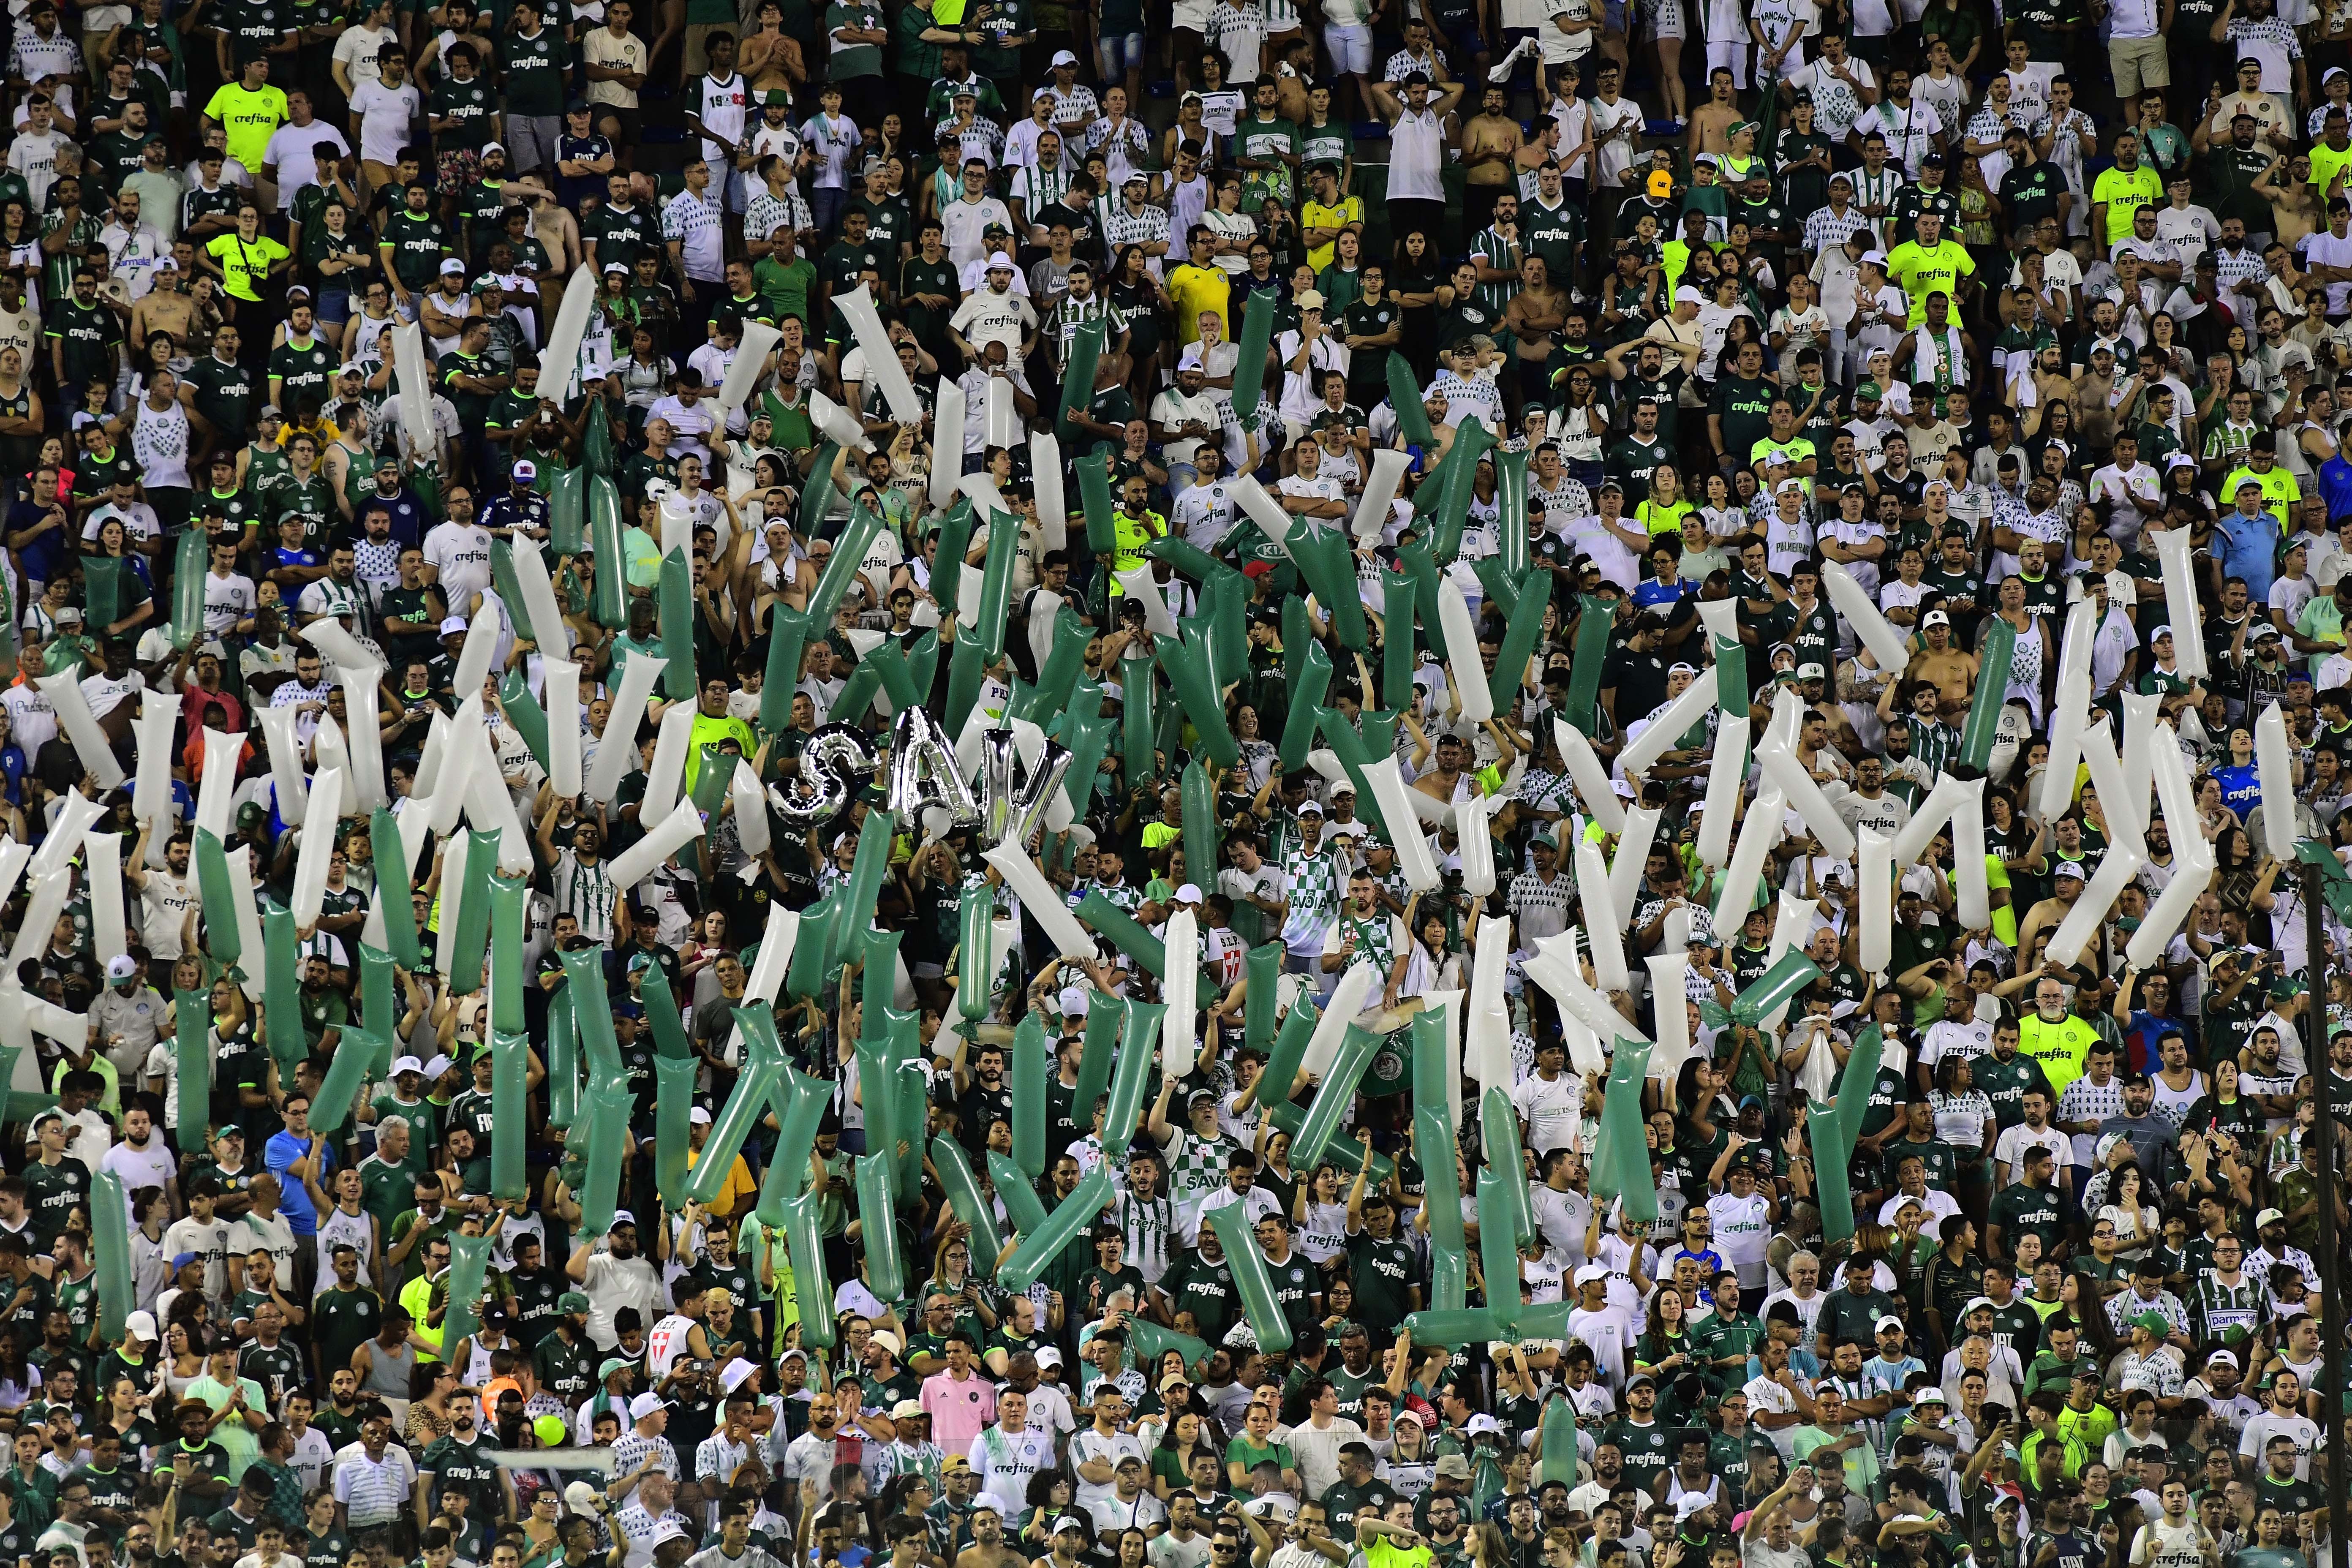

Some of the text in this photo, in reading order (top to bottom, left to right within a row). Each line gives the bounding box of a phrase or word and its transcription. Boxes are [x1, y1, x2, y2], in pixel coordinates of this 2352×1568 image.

[2180, 1, 2213, 14] crefisa
[981, 19, 1016, 30] crefisa
[240, 26, 275, 38] crefisa
[511, 56, 548, 70] crefisa
[448, 104, 483, 118] crefisa
[234, 113, 271, 125] crefisa
[1033, 187, 1065, 198] crefisa
[2014, 187, 2046, 201] crefisa
[2115, 193, 2148, 206] crefisa
[607, 228, 641, 242] crefisa
[1534, 228, 1569, 242] crefisa
[2169, 234, 2201, 245] crefisa
[404, 238, 439, 253] crefisa
[1916, 268, 1951, 280] crefisa
[1119, 304, 1152, 319] crefisa
[984, 315, 1018, 327] crefisa
[68, 328, 102, 340] crefisa
[286, 371, 323, 387] crefisa
[1732, 400, 1769, 414] crefisa
[1807, 416, 1831, 429] efisa
[1912, 453, 1947, 465] crefisa
[893, 478, 924, 490] crefisa
[1196, 509, 1226, 525] crefisa
[302, 522, 316, 535] 10
[1777, 542, 1810, 554] PALMEIRAS
[455, 550, 488, 563] crefisa
[862, 556, 887, 571] efisa
[2023, 602, 2055, 615] crefisa
[1260, 668, 1286, 679] crefisa
[2154, 679, 2168, 693] 78
[5, 756, 14, 768] P
[1856, 818, 1895, 830] crefisa
[1946, 1045, 1985, 1057] crefisa
[2033, 1049, 2072, 1061] crefisa
[41, 1192, 80, 1208] crefisa
[2018, 1213, 2058, 1224] crefisa
[1130, 1218, 1168, 1233] crefisa
[1725, 1222, 1759, 1233] crefisa
[1372, 1258, 1406, 1279] crefisa
[1187, 1282, 1225, 1297] crefisa
[2262, 1373, 2270, 1381] P
[1477, 1418, 1484, 1426] P
[1625, 1451, 1666, 1468] crefisa
[994, 1464, 1034, 1474] crefisa
[2156, 1552, 2200, 1568] crefisa
